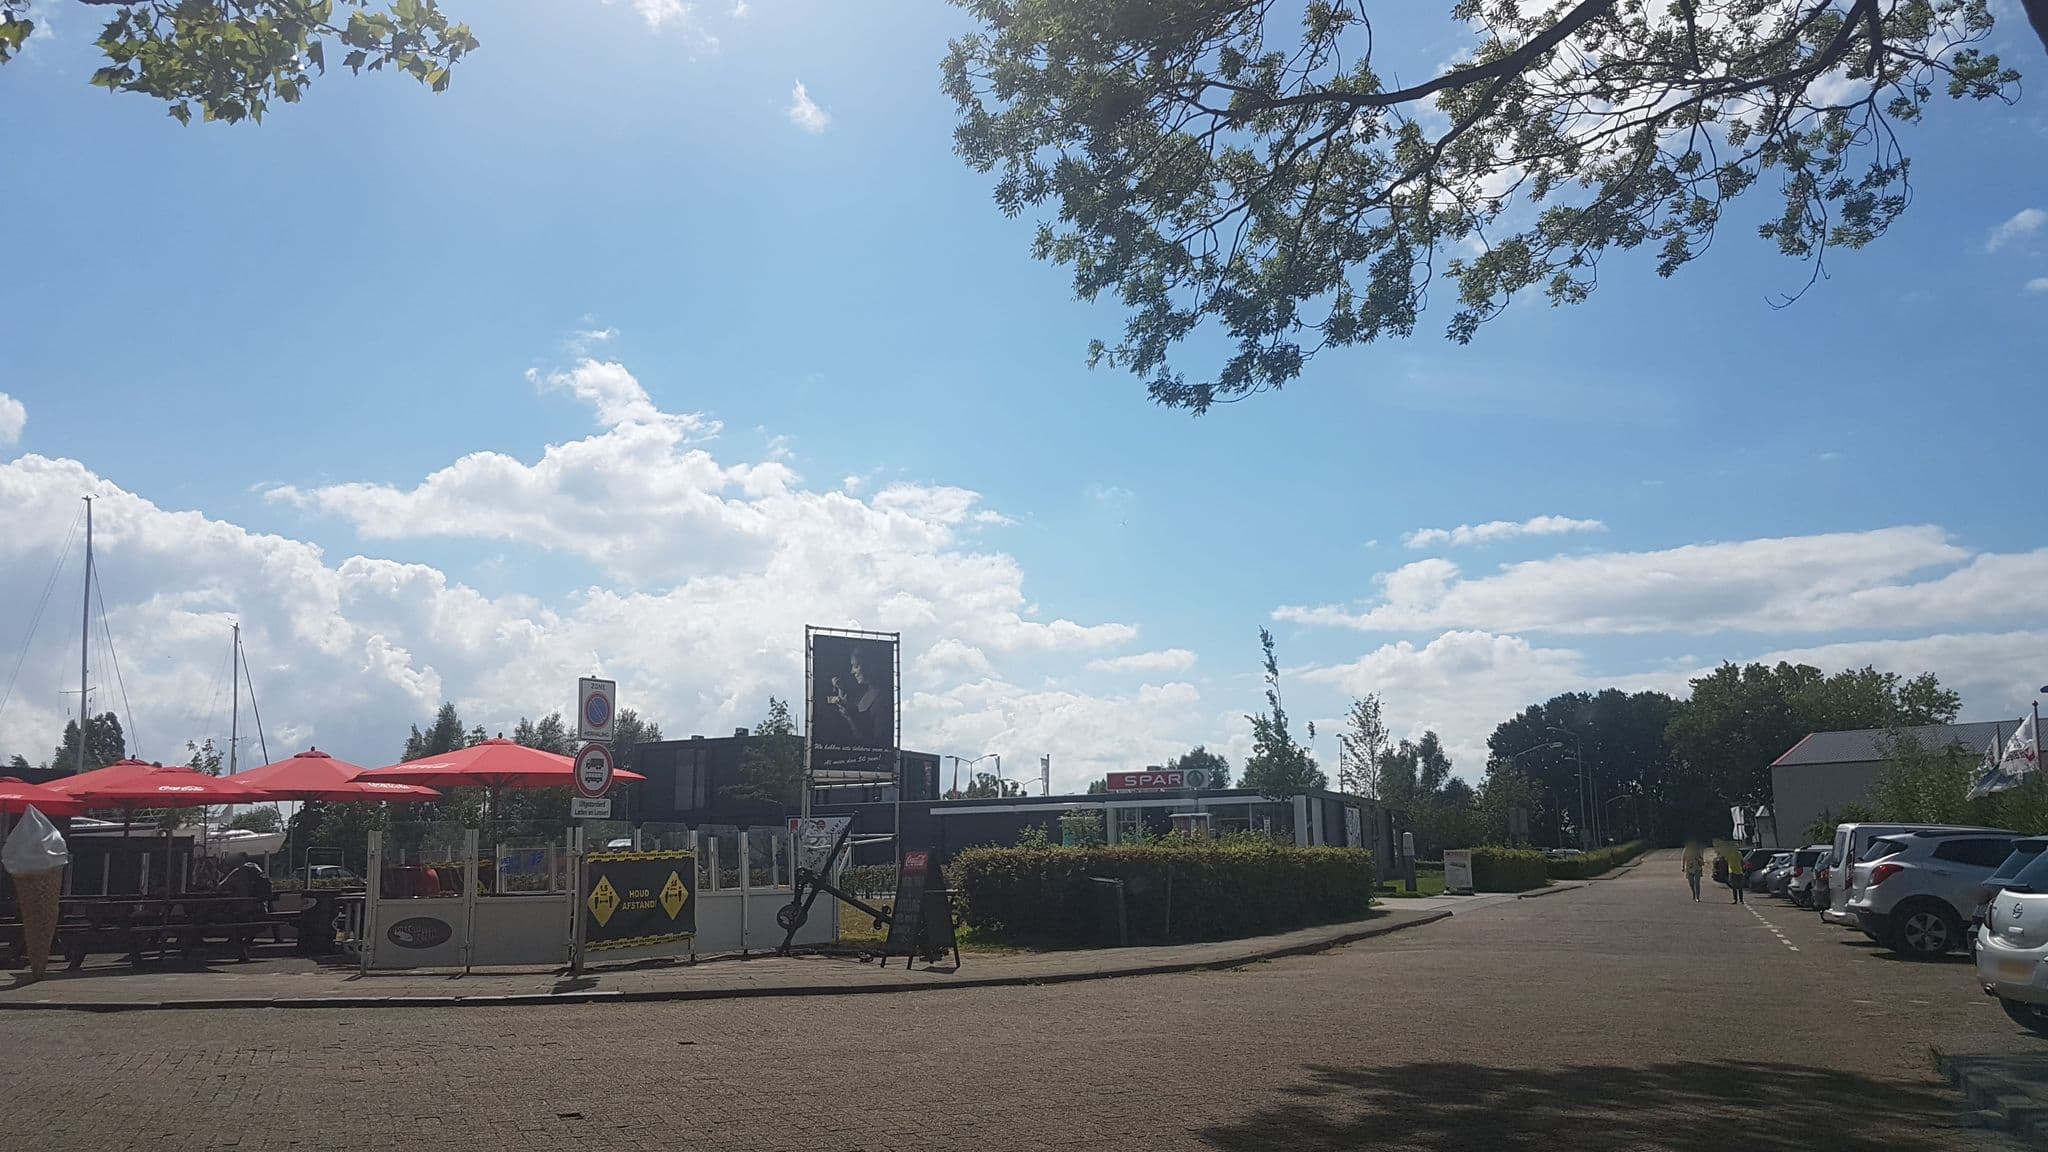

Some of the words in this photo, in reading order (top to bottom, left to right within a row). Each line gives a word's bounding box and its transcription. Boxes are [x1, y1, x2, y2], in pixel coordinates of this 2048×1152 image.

[591, 682, 606, 690] ZONE
[1124, 774, 1182, 786] SPAR
[629, 890, 650, 899] HOUD
[622, 900, 658, 910] AFSTAND!
